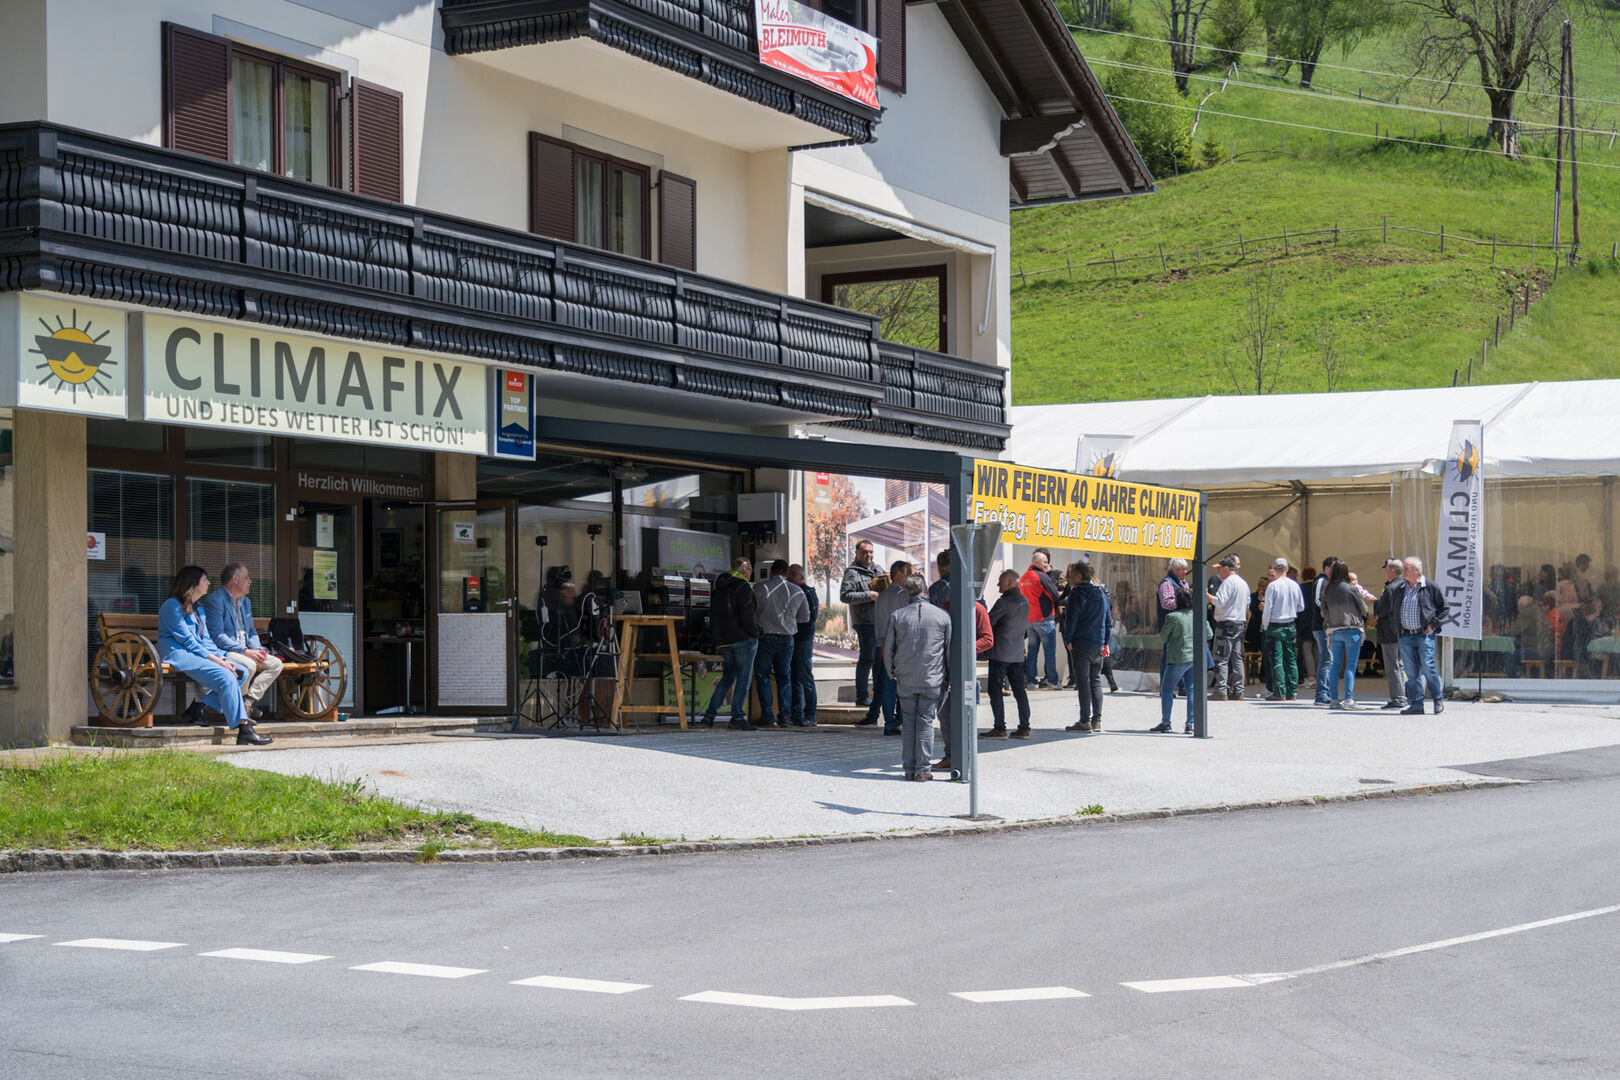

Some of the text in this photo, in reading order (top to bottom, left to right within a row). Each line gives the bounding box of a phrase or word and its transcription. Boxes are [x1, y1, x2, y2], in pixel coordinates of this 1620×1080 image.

[760, 0, 792, 24] Maler
[762, 29, 827, 50] BLEIMUTH
[165, 327, 463, 421] CLIMAFIX
[504, 404, 528, 414] PARTNER
[510, 396, 521, 404] TOP
[166, 397, 464, 446] UND JEDES WETTER IST SCHÖN!
[298, 472, 424, 498] Herzlich Willkommen!
[977, 464, 1198, 522] WIR FEIERN 40 JAHRE CLIMAFIX
[1034, 509, 1054, 537] 19.
[1058, 512, 1081, 539] Mai
[1084, 515, 1115, 543] 2023
[1118, 524, 1138, 545] von
[1142, 521, 1172, 549] 10-18
[1174, 525, 1194, 550] Uhr
